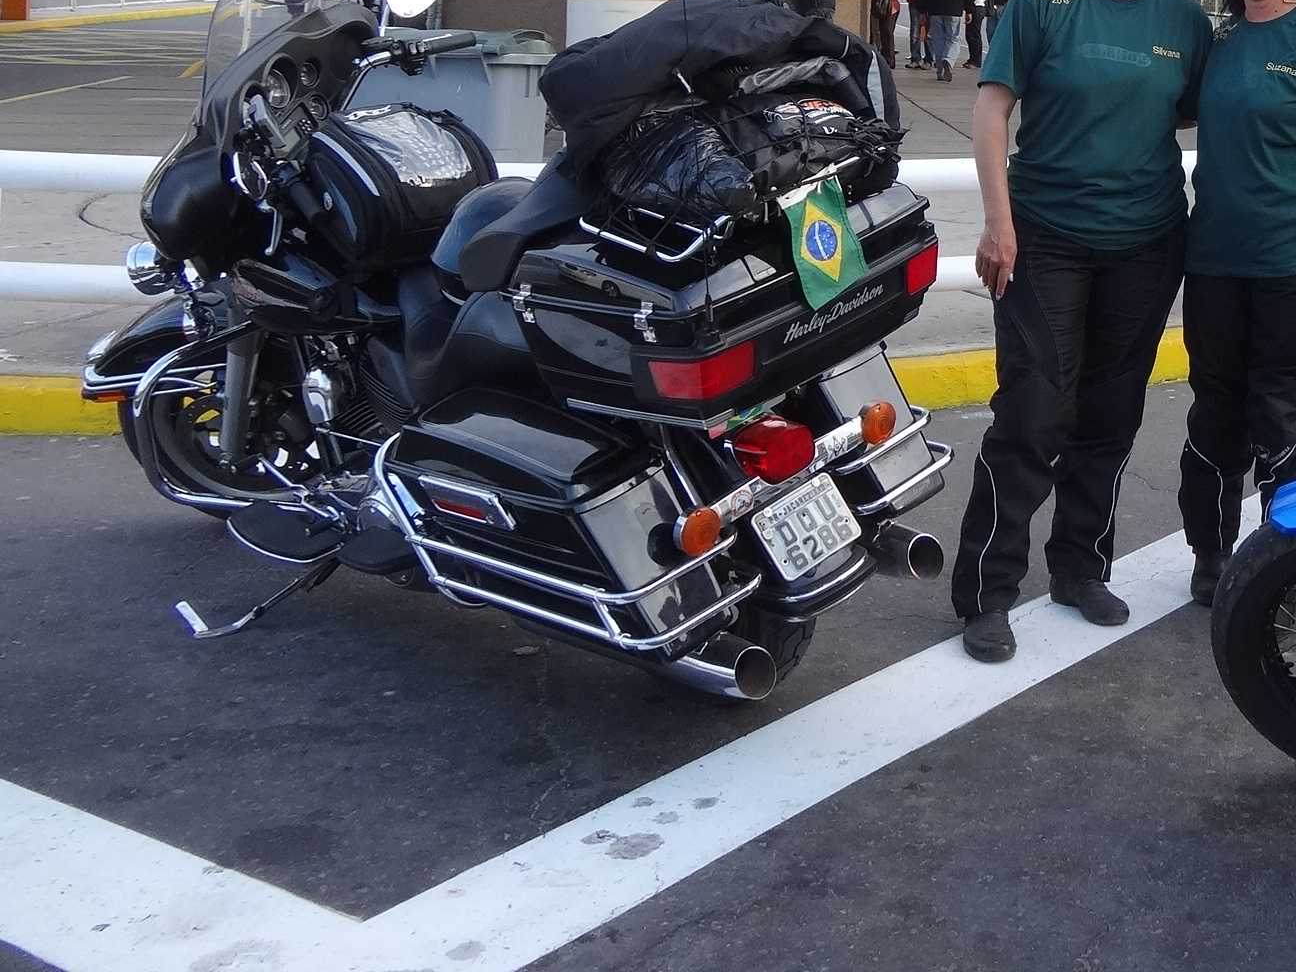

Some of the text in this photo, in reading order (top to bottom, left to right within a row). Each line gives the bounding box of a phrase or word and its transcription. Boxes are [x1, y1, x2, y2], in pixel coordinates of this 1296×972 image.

[1152, 45, 1181, 59] Silvana
[783, 284, 884, 345] Harley-Davidson
[786, 516, 853, 570] 6286
